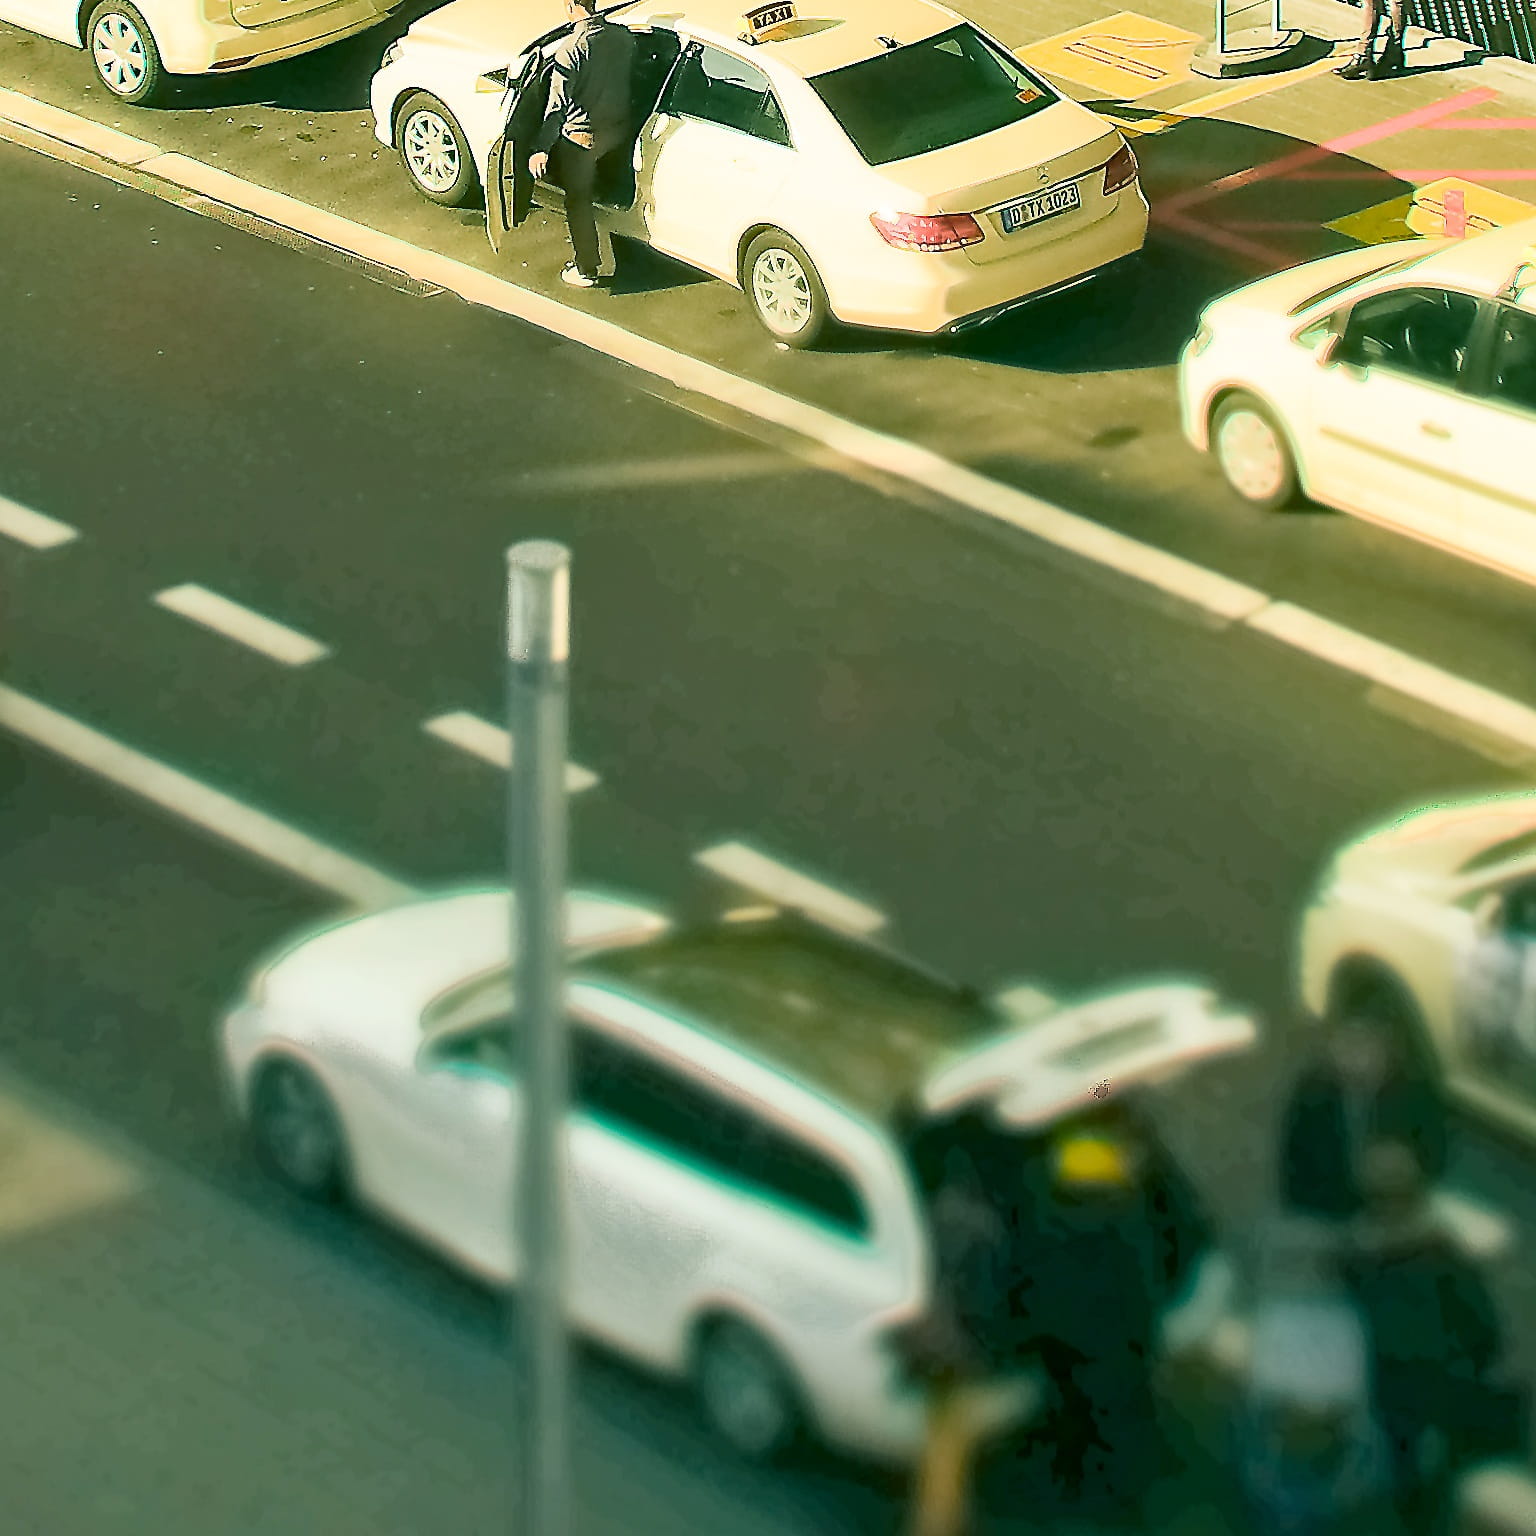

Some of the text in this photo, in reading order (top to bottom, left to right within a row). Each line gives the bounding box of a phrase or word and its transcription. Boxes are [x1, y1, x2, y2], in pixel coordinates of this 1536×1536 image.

[757, 6, 788, 27] TAXI
[1011, 206, 1021, 224] D
[1046, 187, 1077, 212] 1023
